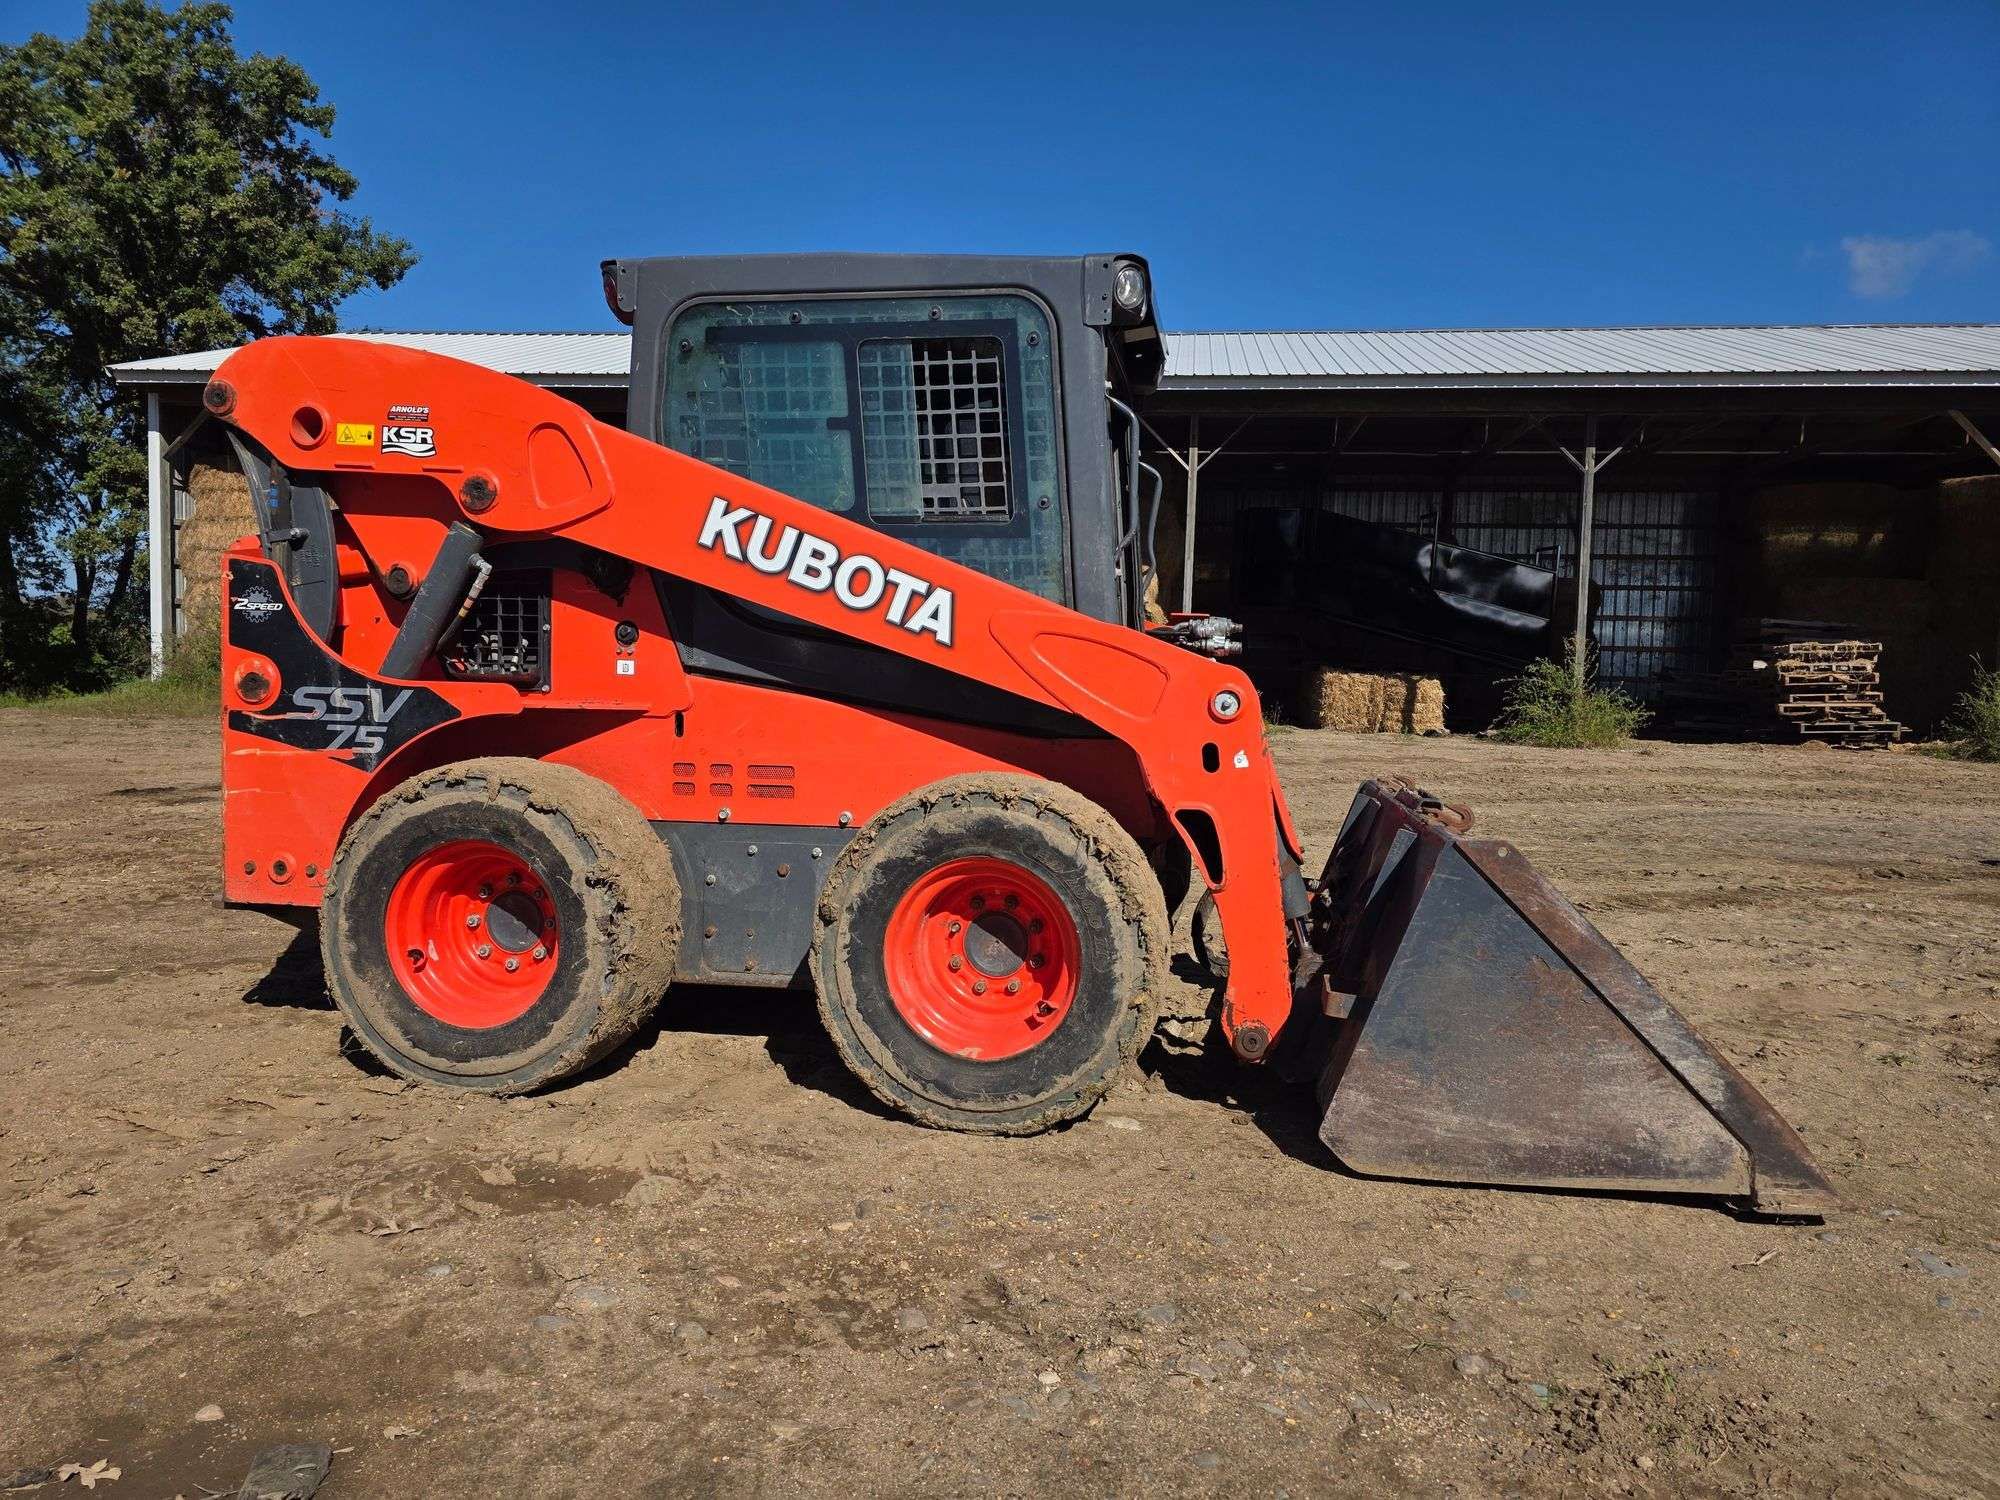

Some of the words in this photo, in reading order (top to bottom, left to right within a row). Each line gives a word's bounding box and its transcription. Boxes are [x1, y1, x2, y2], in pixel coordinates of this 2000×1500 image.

[390, 405, 429, 414] ARNOLD'S
[382, 426, 434, 444] KSR
[698, 496, 953, 647] KUBOTA
[293, 686, 414, 723] SSV
[326, 725, 387, 754] 75
